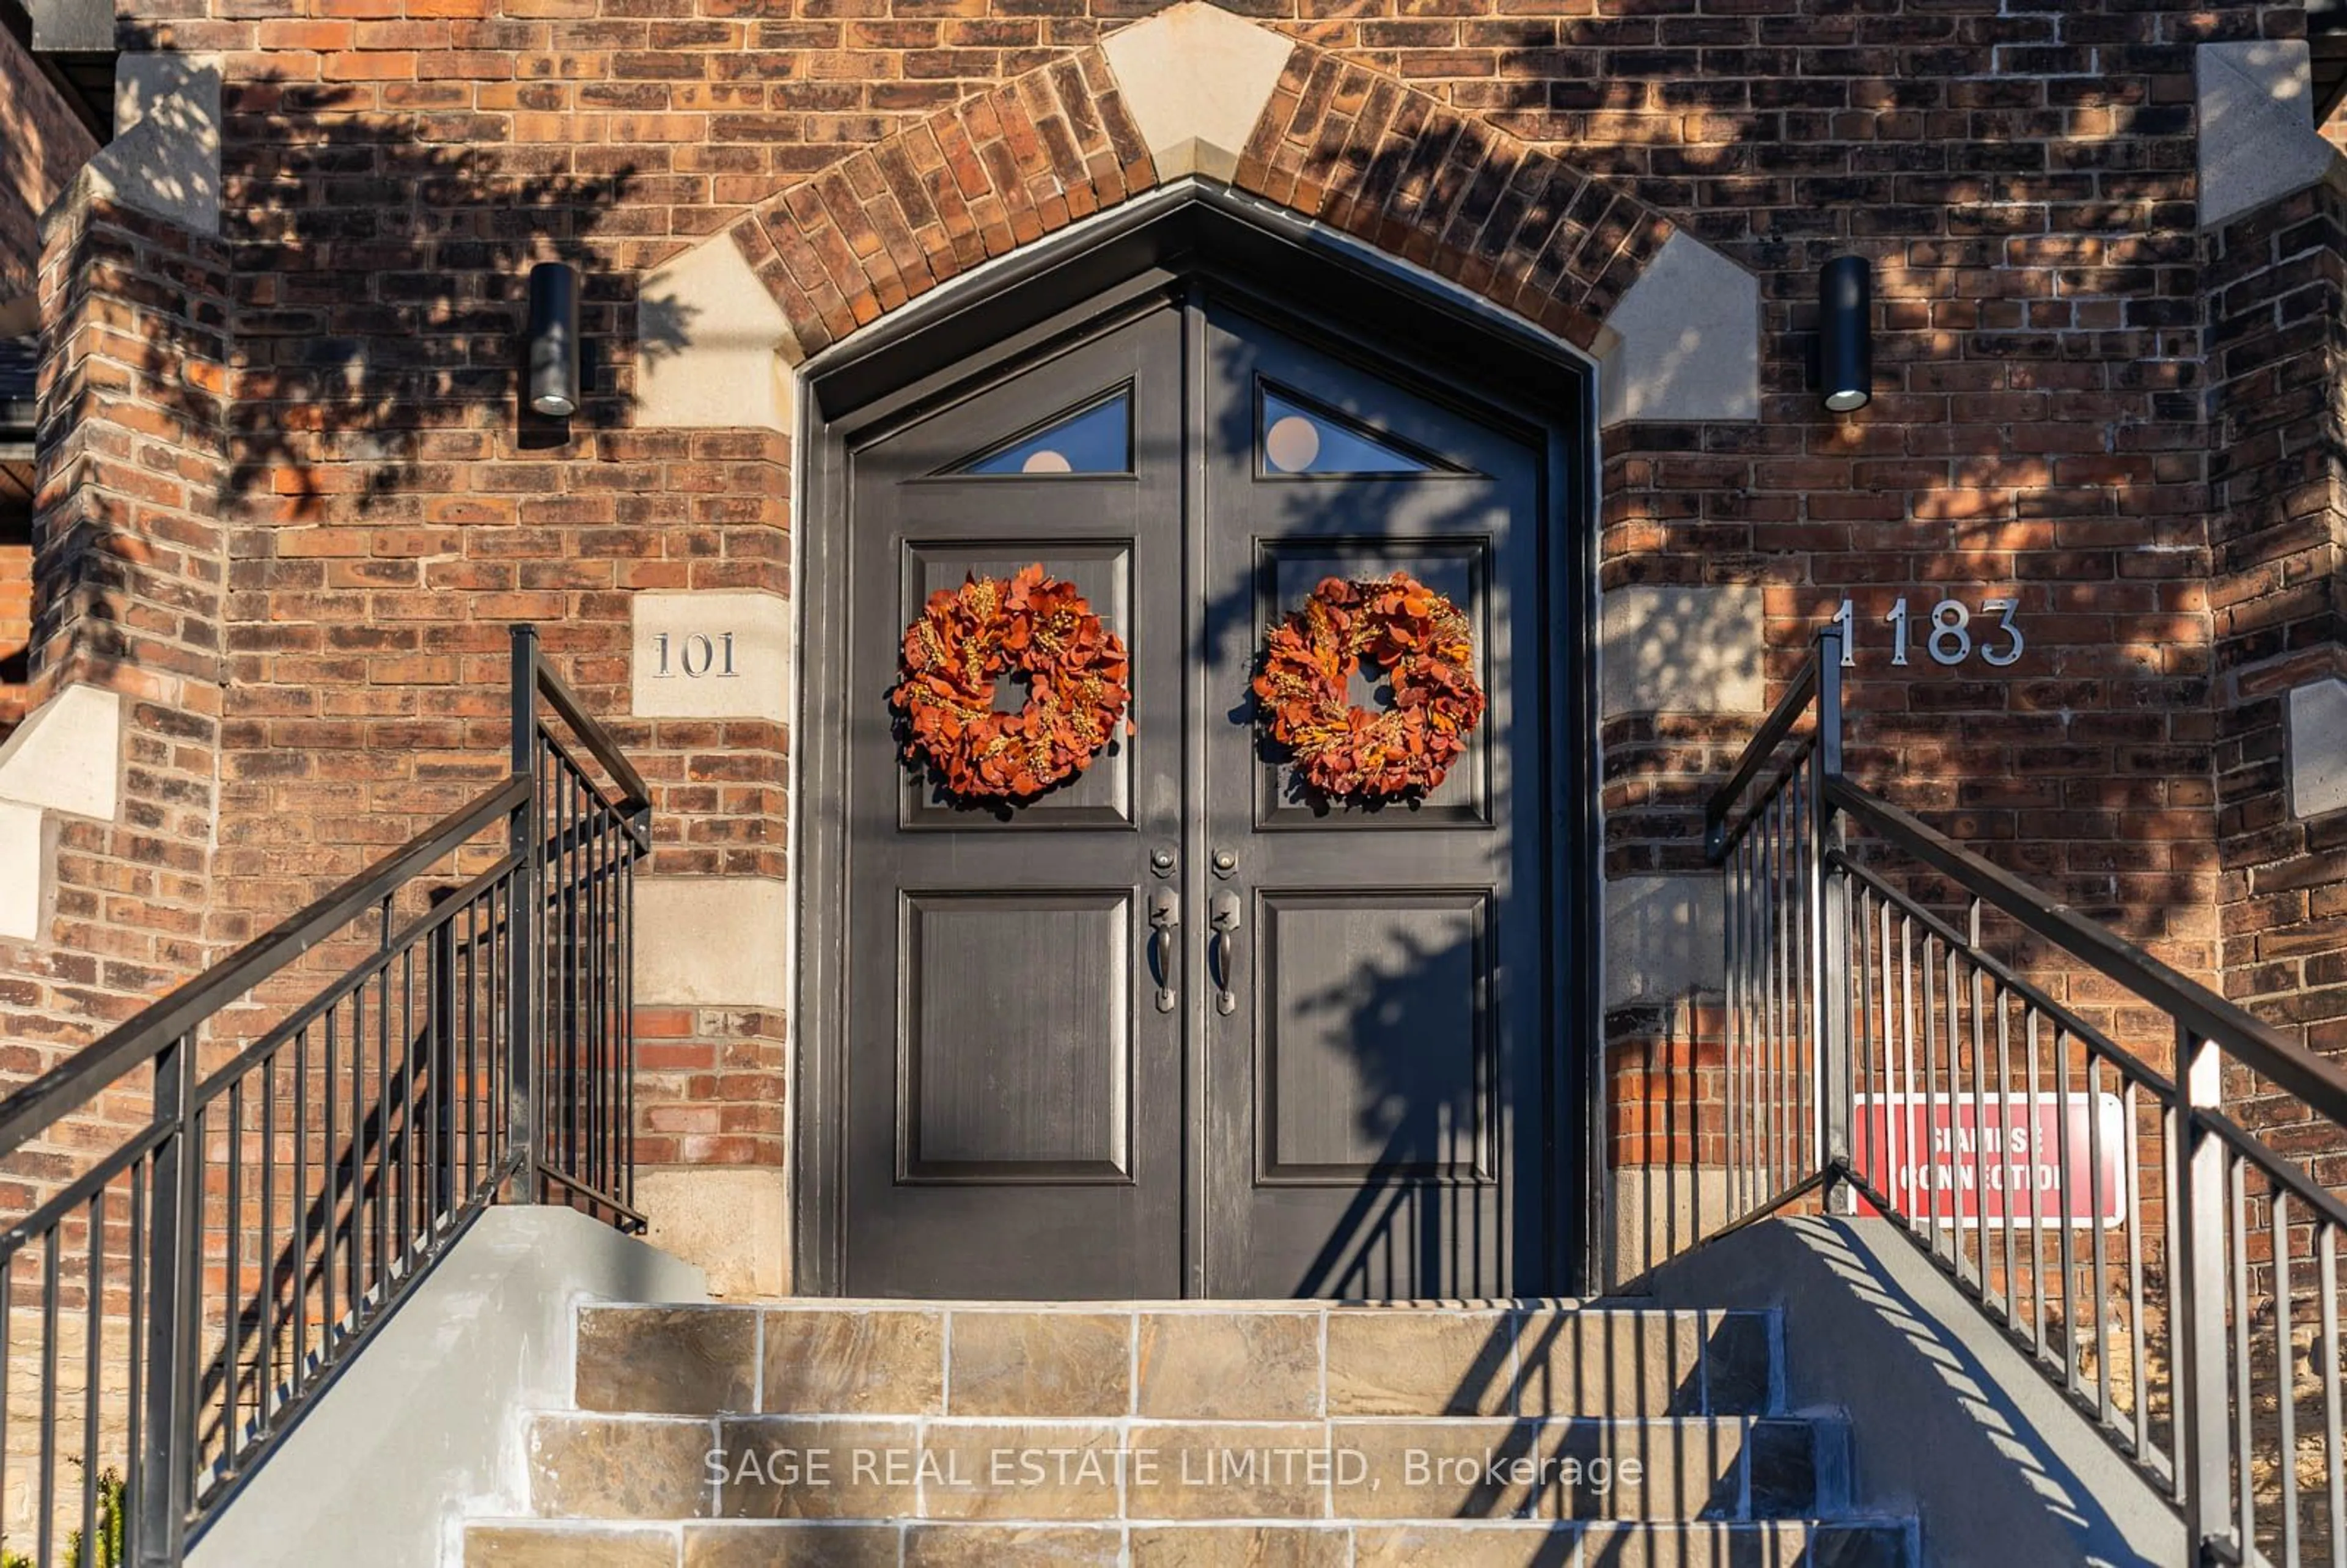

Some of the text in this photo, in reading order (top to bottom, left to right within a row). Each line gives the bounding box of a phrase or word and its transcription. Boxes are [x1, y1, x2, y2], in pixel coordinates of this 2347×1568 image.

[1833, 598, 2024, 667] 1183
[652, 632, 740, 678] 101
[1934, 1127, 2043, 1153] SIAMS
[1900, 1163, 2061, 1191] CONNCTIO
